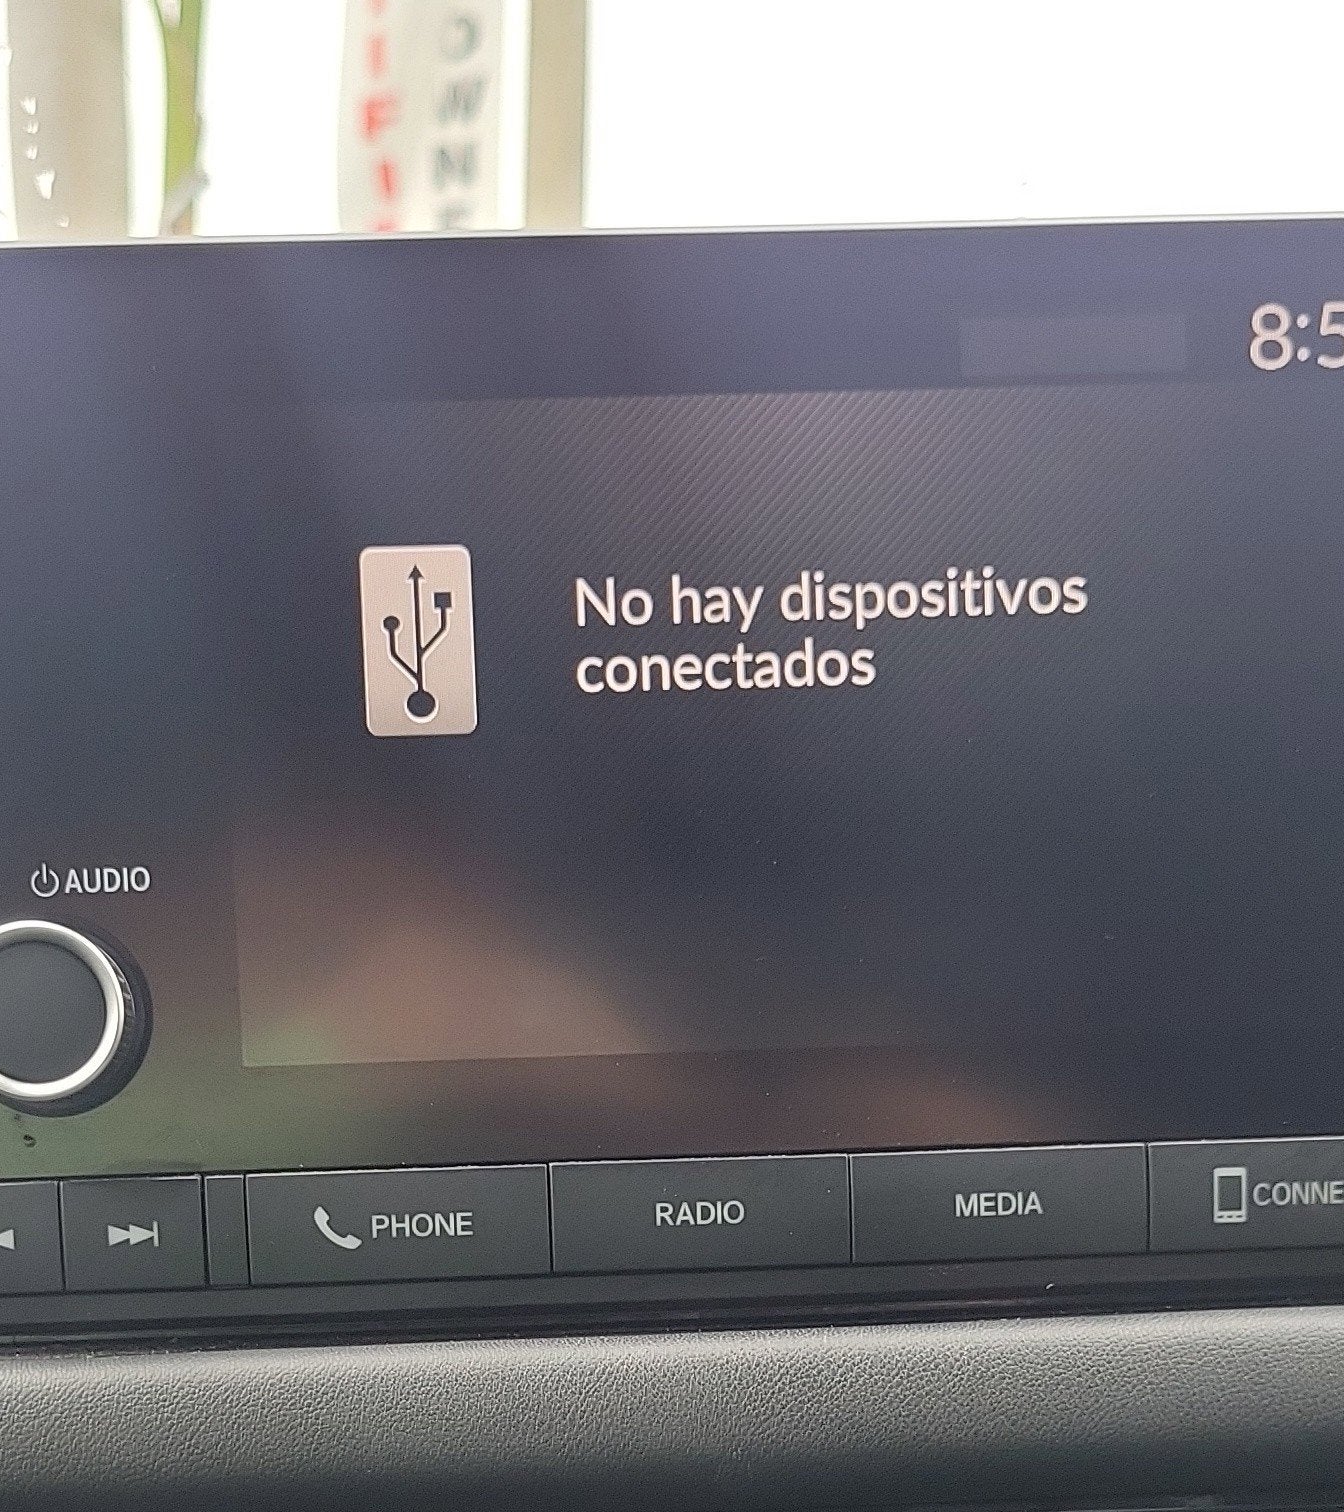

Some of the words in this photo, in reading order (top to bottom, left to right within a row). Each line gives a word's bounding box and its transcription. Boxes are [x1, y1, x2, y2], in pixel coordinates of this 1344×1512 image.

[575, 576, 654, 627] No
[671, 573, 764, 633] hay
[780, 565, 1088, 630] dispositivos
[576, 636, 876, 693] conectados
[64, 866, 151, 894] AUDIO
[655, 1200, 745, 1226] RADIO
[955, 1191, 1043, 1217] MEDIA
[371, 1212, 474, 1239] PHONE
